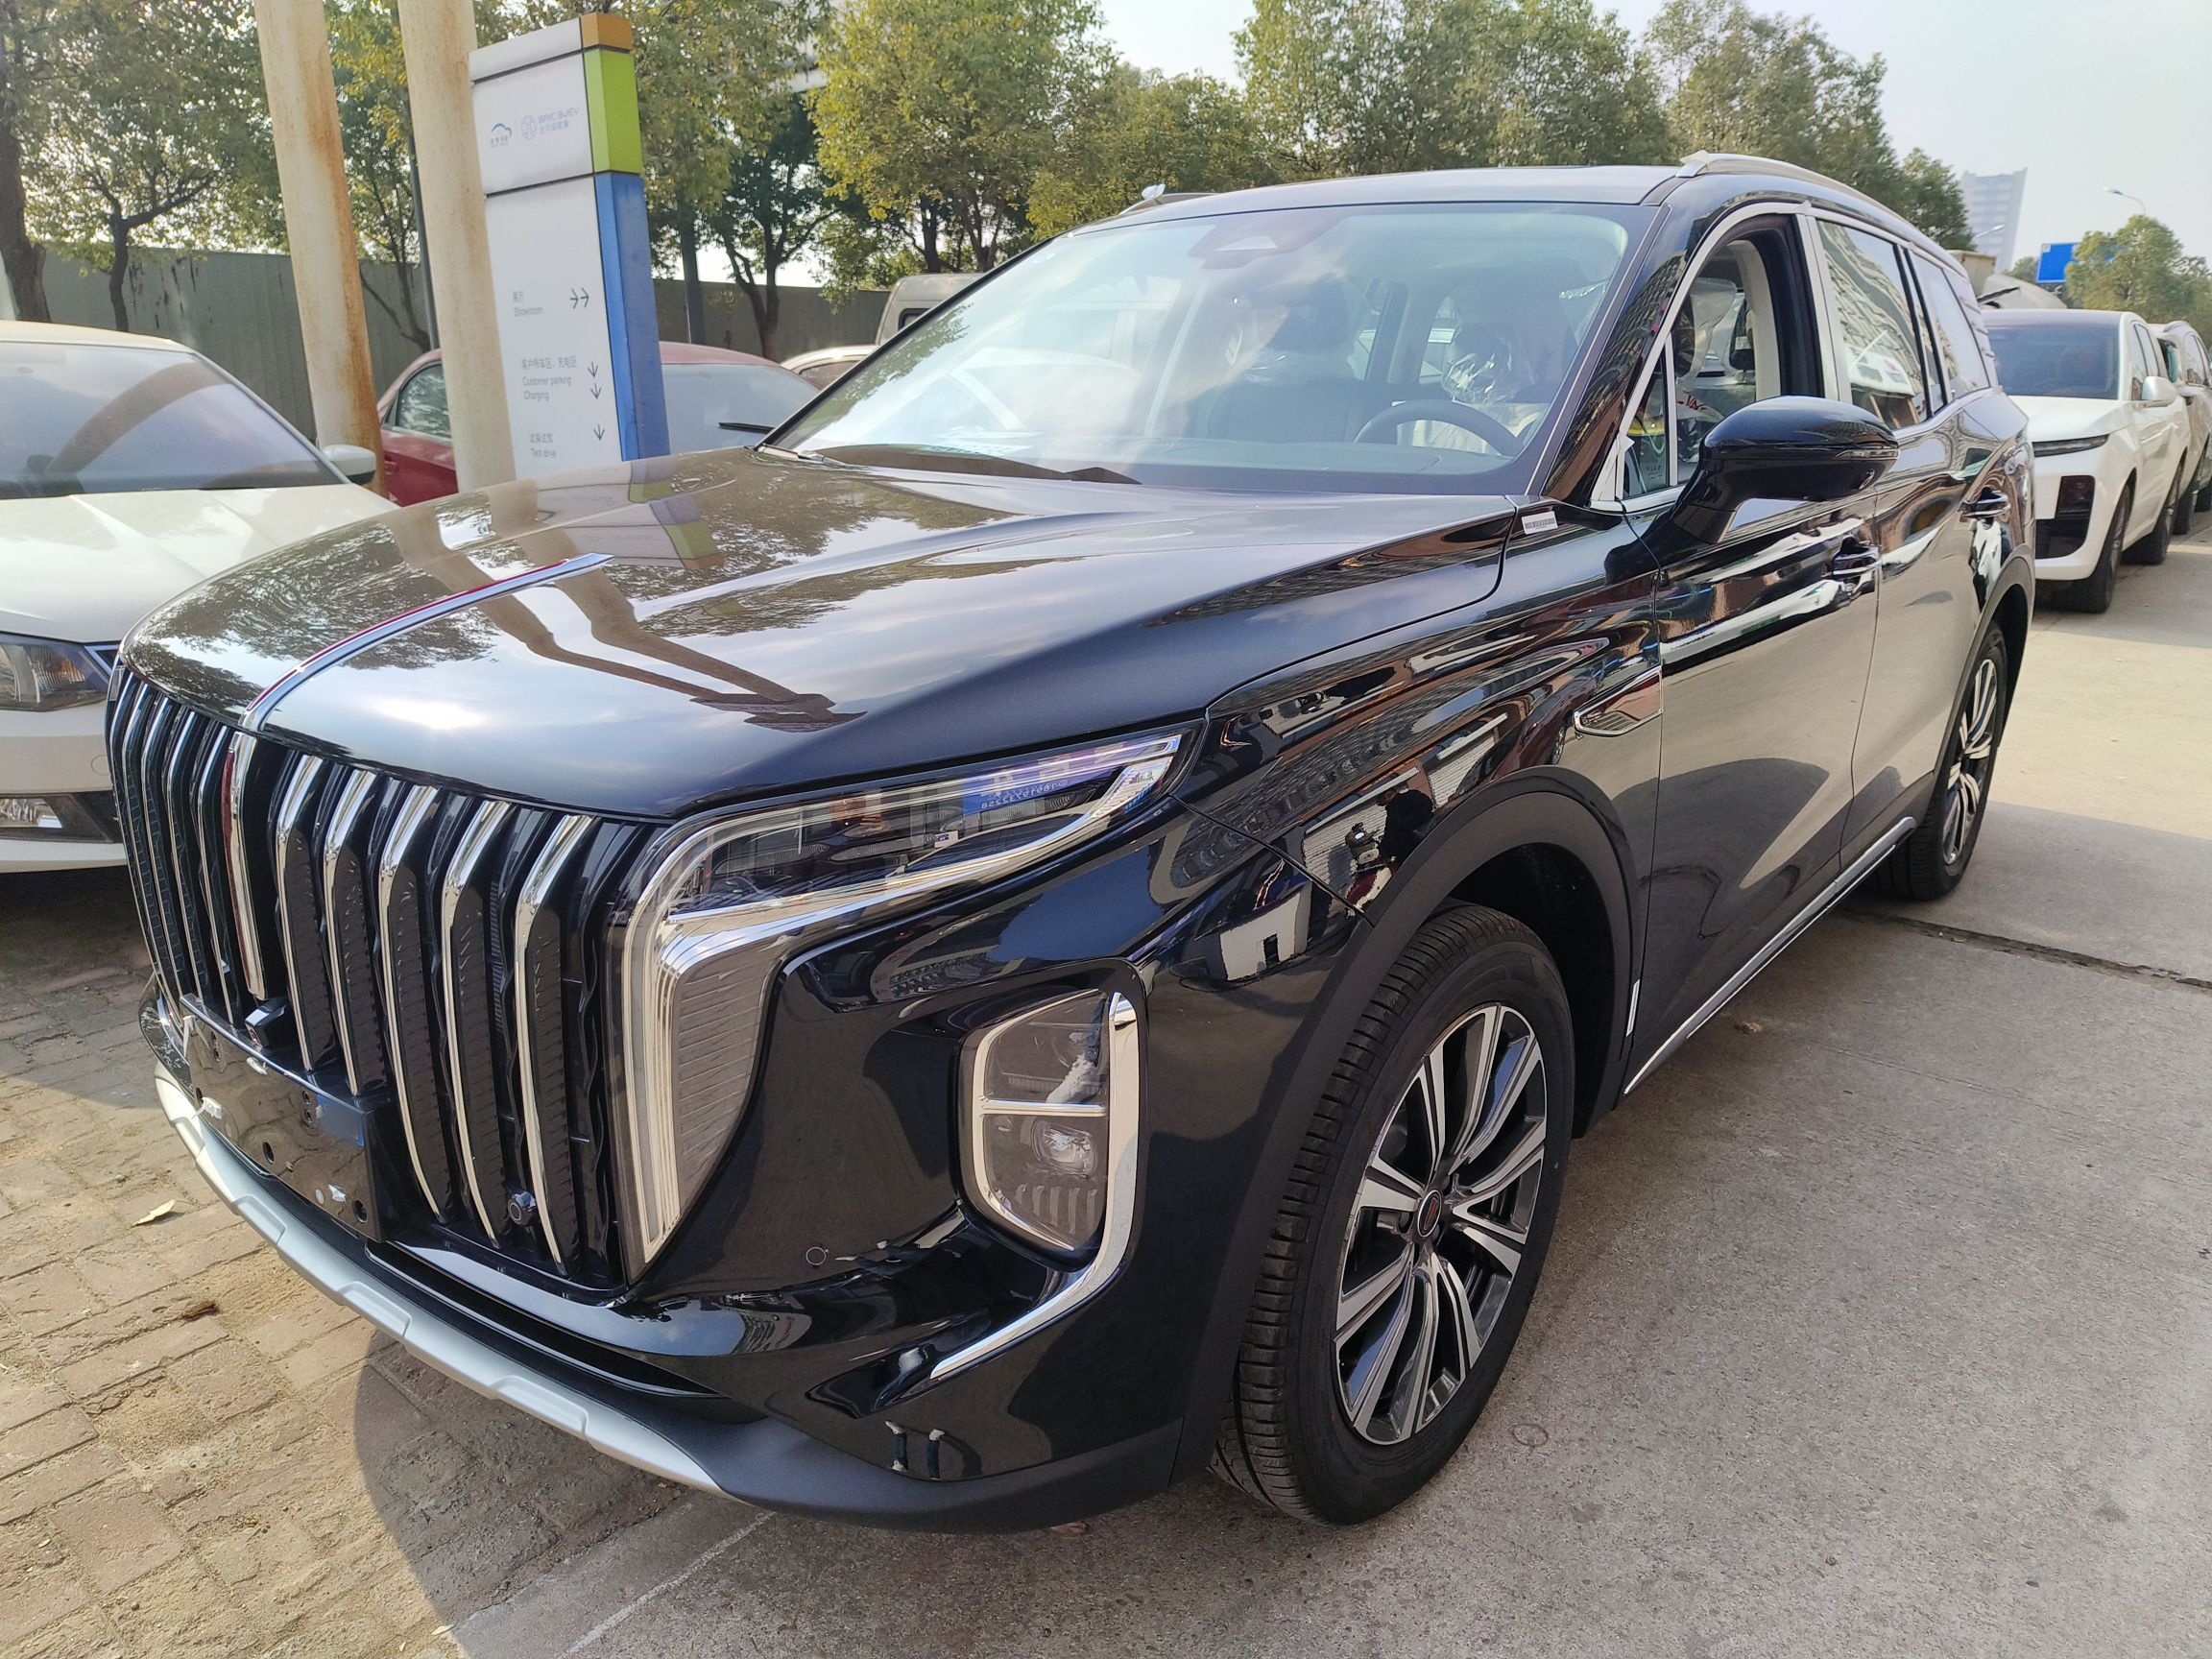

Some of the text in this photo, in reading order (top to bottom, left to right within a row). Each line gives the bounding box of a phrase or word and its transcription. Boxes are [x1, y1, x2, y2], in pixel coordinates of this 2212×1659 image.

[514, 305, 544, 317] Showroom
[522, 374, 572, 387] Customer parking
[524, 390, 549, 402] Charging
[530, 447, 557, 458] Test drive
